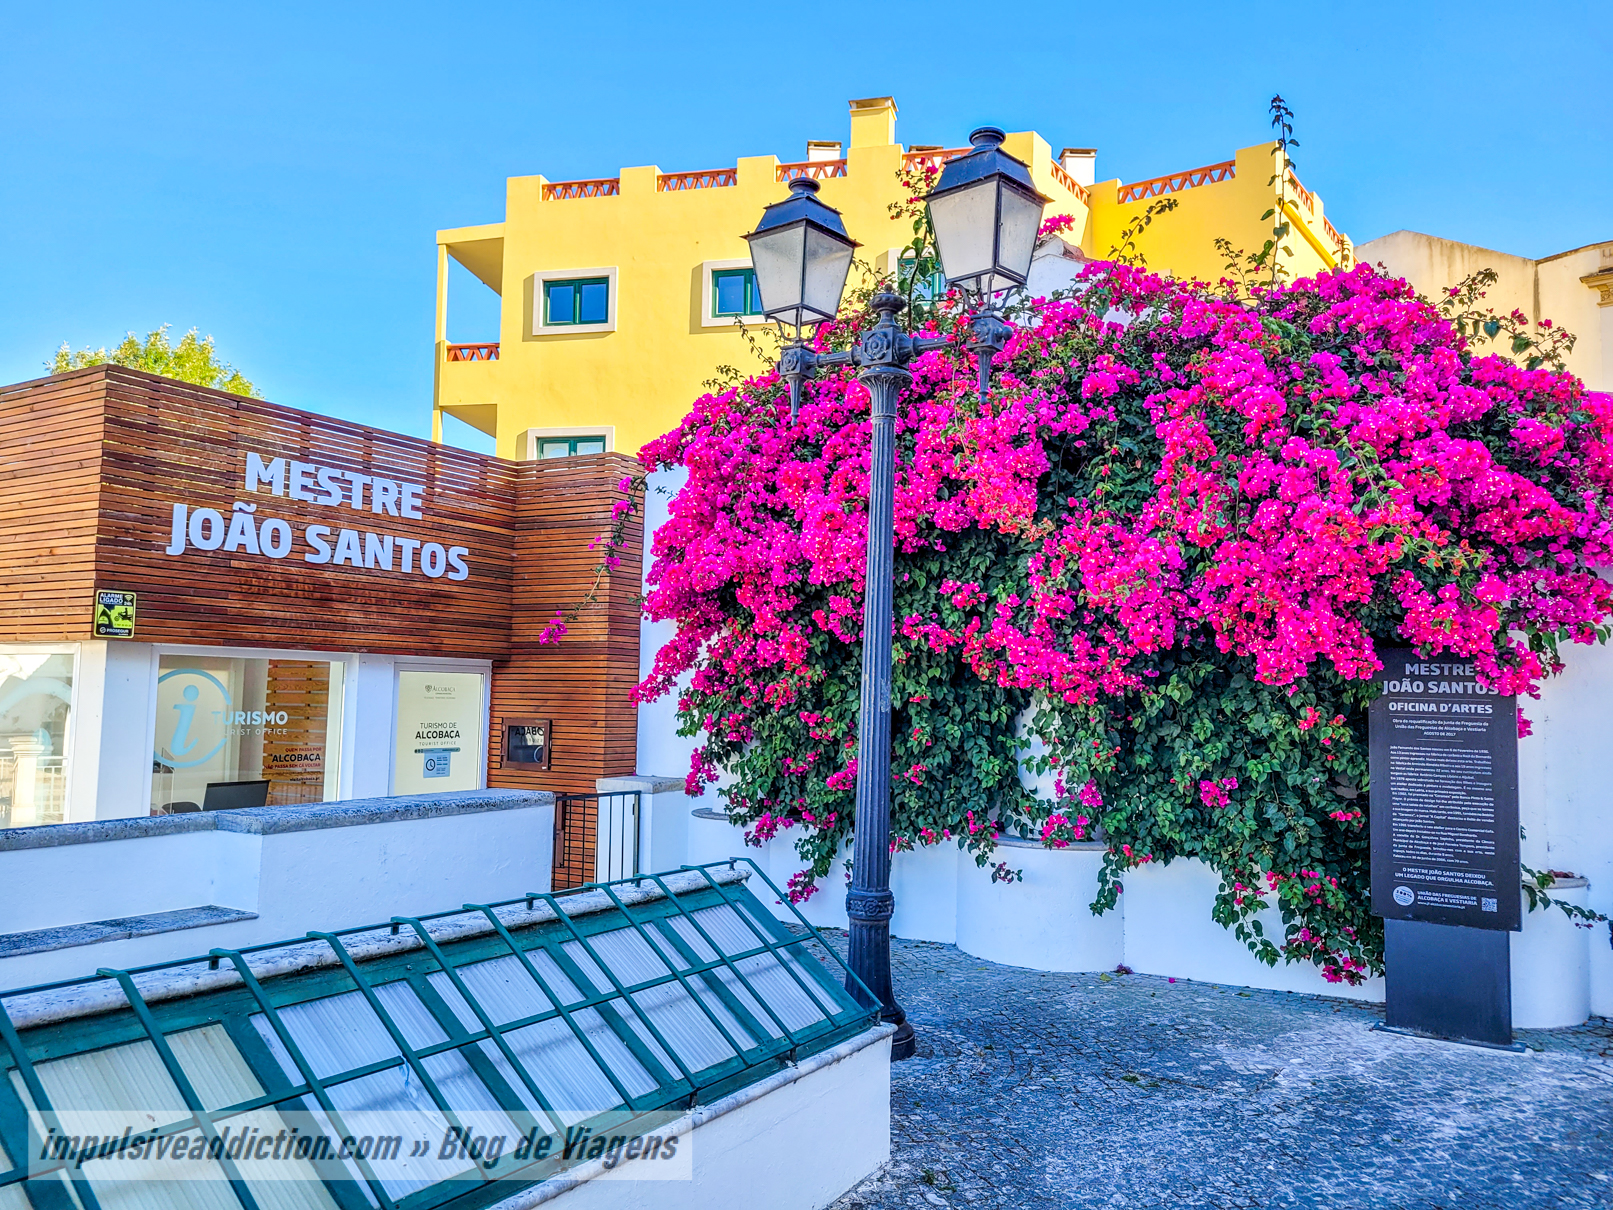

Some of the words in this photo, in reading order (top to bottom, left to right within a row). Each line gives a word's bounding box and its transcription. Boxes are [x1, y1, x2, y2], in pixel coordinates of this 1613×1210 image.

[245, 452, 424, 520] MESTRE
[166, 502, 292, 559] JOÃO
[304, 525, 469, 581] SANTOS
[1405, 663, 1475, 676] MESTRE
[1382, 678, 1424, 695] JOÃO
[1388, 702, 1437, 712] OFICINA
[211, 710, 288, 726] TURISMO
[415, 730, 460, 739] ALCOBAÇA
[272, 754, 321, 762] ALCOBAÇA
